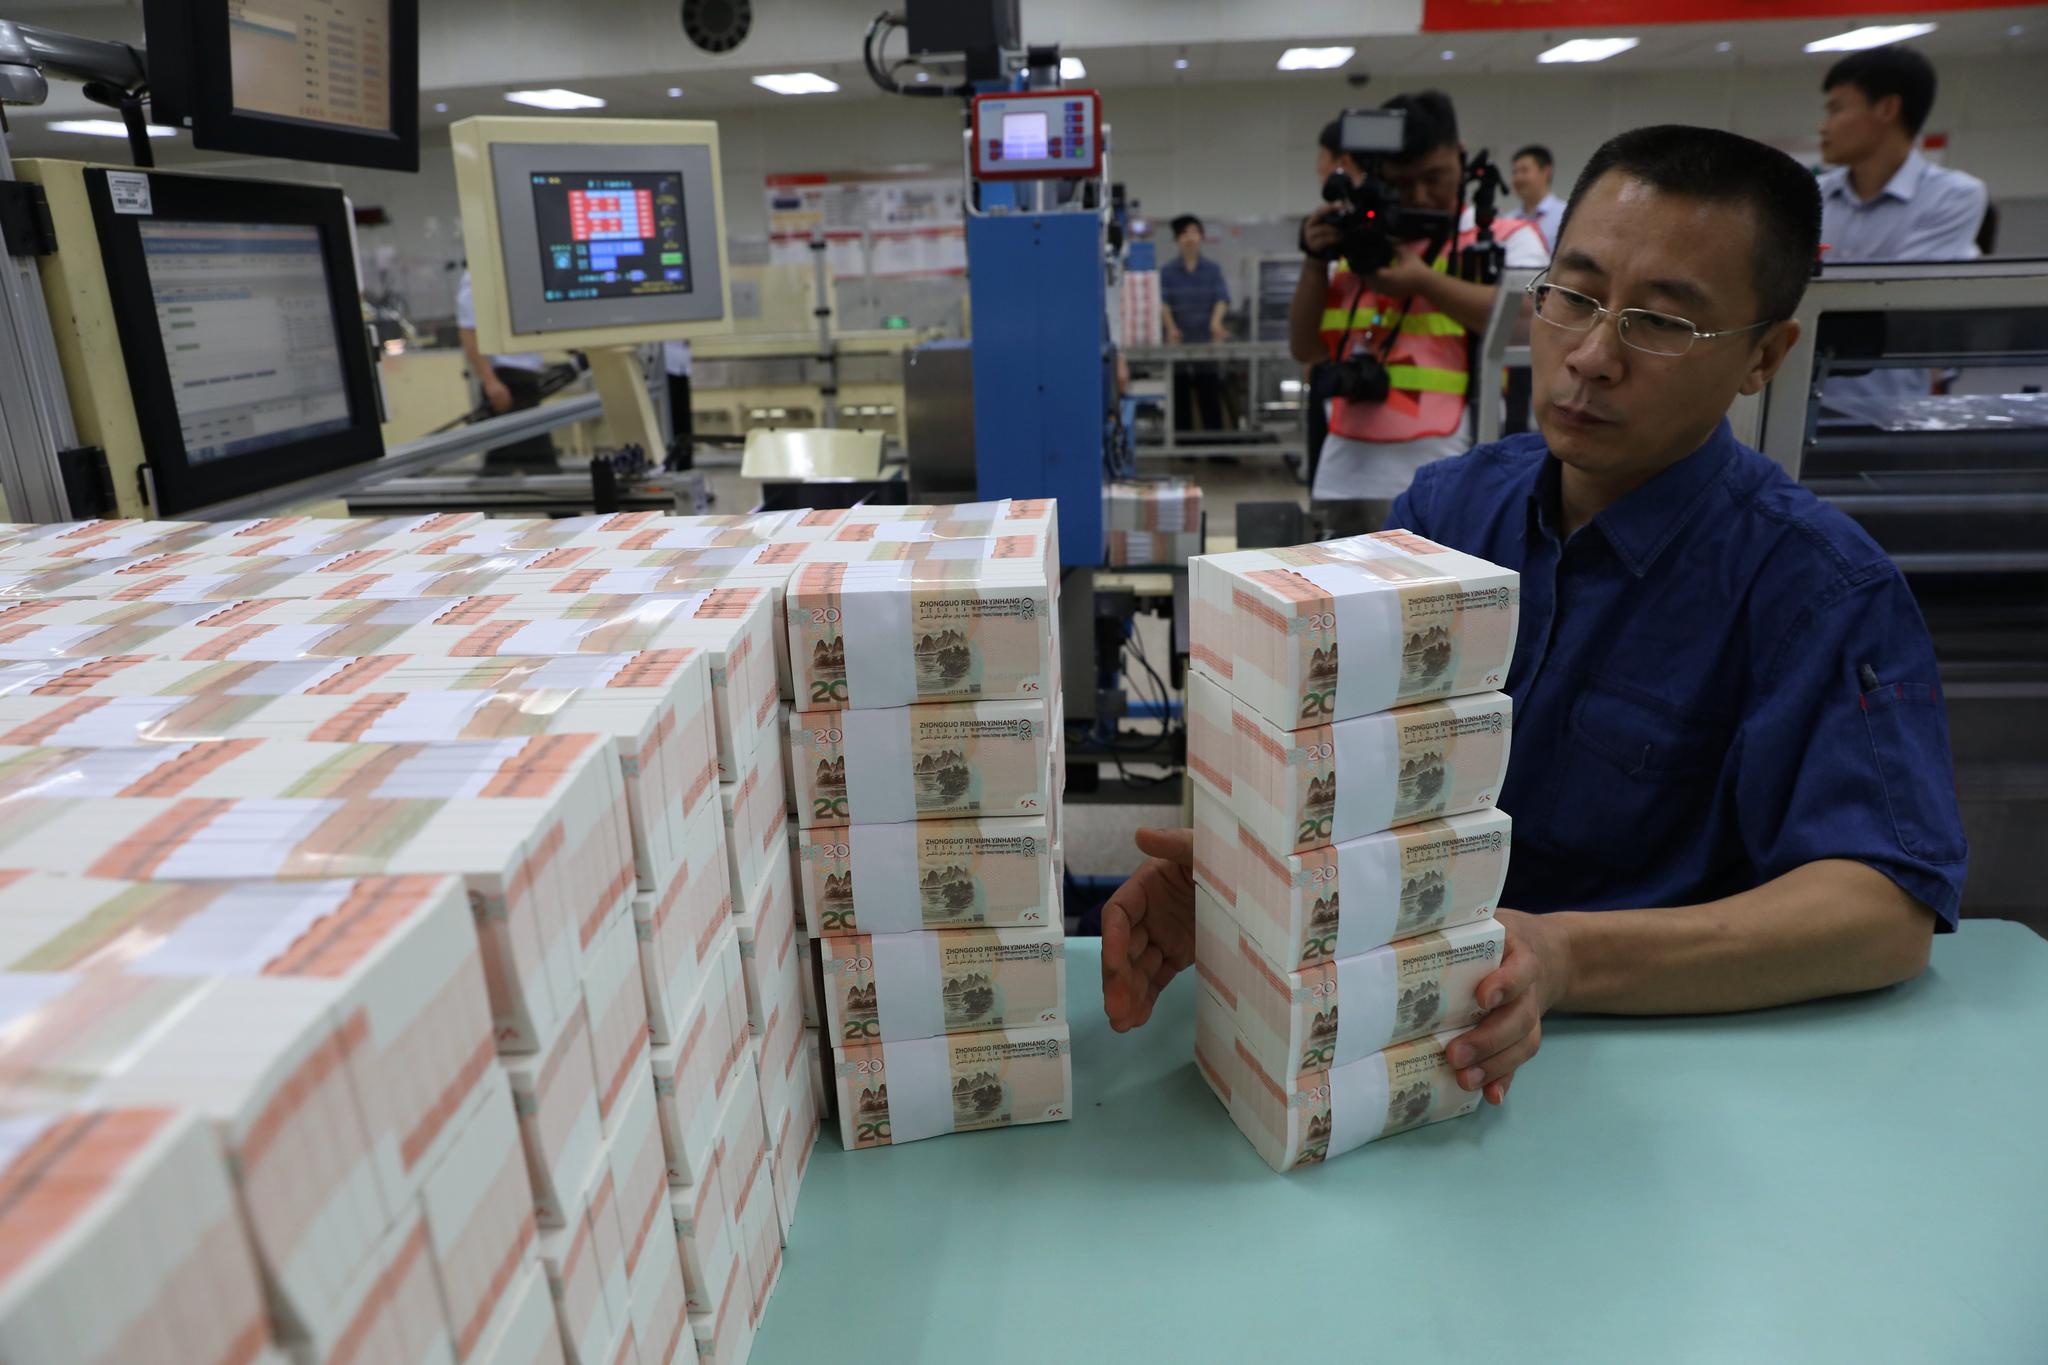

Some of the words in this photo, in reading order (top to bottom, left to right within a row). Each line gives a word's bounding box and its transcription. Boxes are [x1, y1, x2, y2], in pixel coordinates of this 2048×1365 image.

[920, 600, 960, 608] ZHONGGUO
[961, 599, 987, 607] RENMIN
[989, 597, 1020, 605] YINHANG
[1408, 594, 1445, 606] ZHONGGUO
[1446, 591, 1470, 601] RENMIN
[1470, 588, 1497, 597] YINHANG
[811, 607, 841, 624] 20
[1309, 613, 1336, 630] 20
[810, 679, 849, 703] 20
[1301, 690, 1335, 718] 20
[919, 721, 958, 729] ZHONGGUO
[960, 720, 986, 728] RENMIN
[987, 719, 1018, 727] YINHANG
[1403, 722, 1439, 733] ZHONGGUO
[1440, 718, 1464, 728] RENMIN
[1464, 713, 1491, 723] YINHANG
[814, 728, 842, 744] 20
[1308, 743, 1335, 761] 20
[813, 798, 850, 819] 20
[1298, 816, 1333, 843] 20
[925, 838, 964, 846] ZHONGGUO
[965, 838, 990, 846] RENMIN
[991, 836, 1021, 844] YINHANG
[1406, 841, 1440, 854] ZHONGGUO
[1441, 838, 1464, 847] RENMIN
[1464, 832, 1490, 842] YINHANG
[822, 844, 850, 859] 20
[1312, 864, 1338, 881] 20
[822, 909, 856, 931] 20
[945, 946, 983, 955] ZHONGGUO
[984, 945, 1009, 953] RENMIN
[1010, 943, 1040, 951] YINHANG
[1302, 935, 1337, 960] 20
[844, 956, 872, 971] 20
[1402, 953, 1436, 966] ZHONGGUO
[1313, 979, 1337, 998] 20
[844, 1018, 880, 1039] 20
[955, 1046, 991, 1055] ZHONGGUO
[855, 1059, 884, 1074] 20
[857, 1120, 892, 1142] 20
